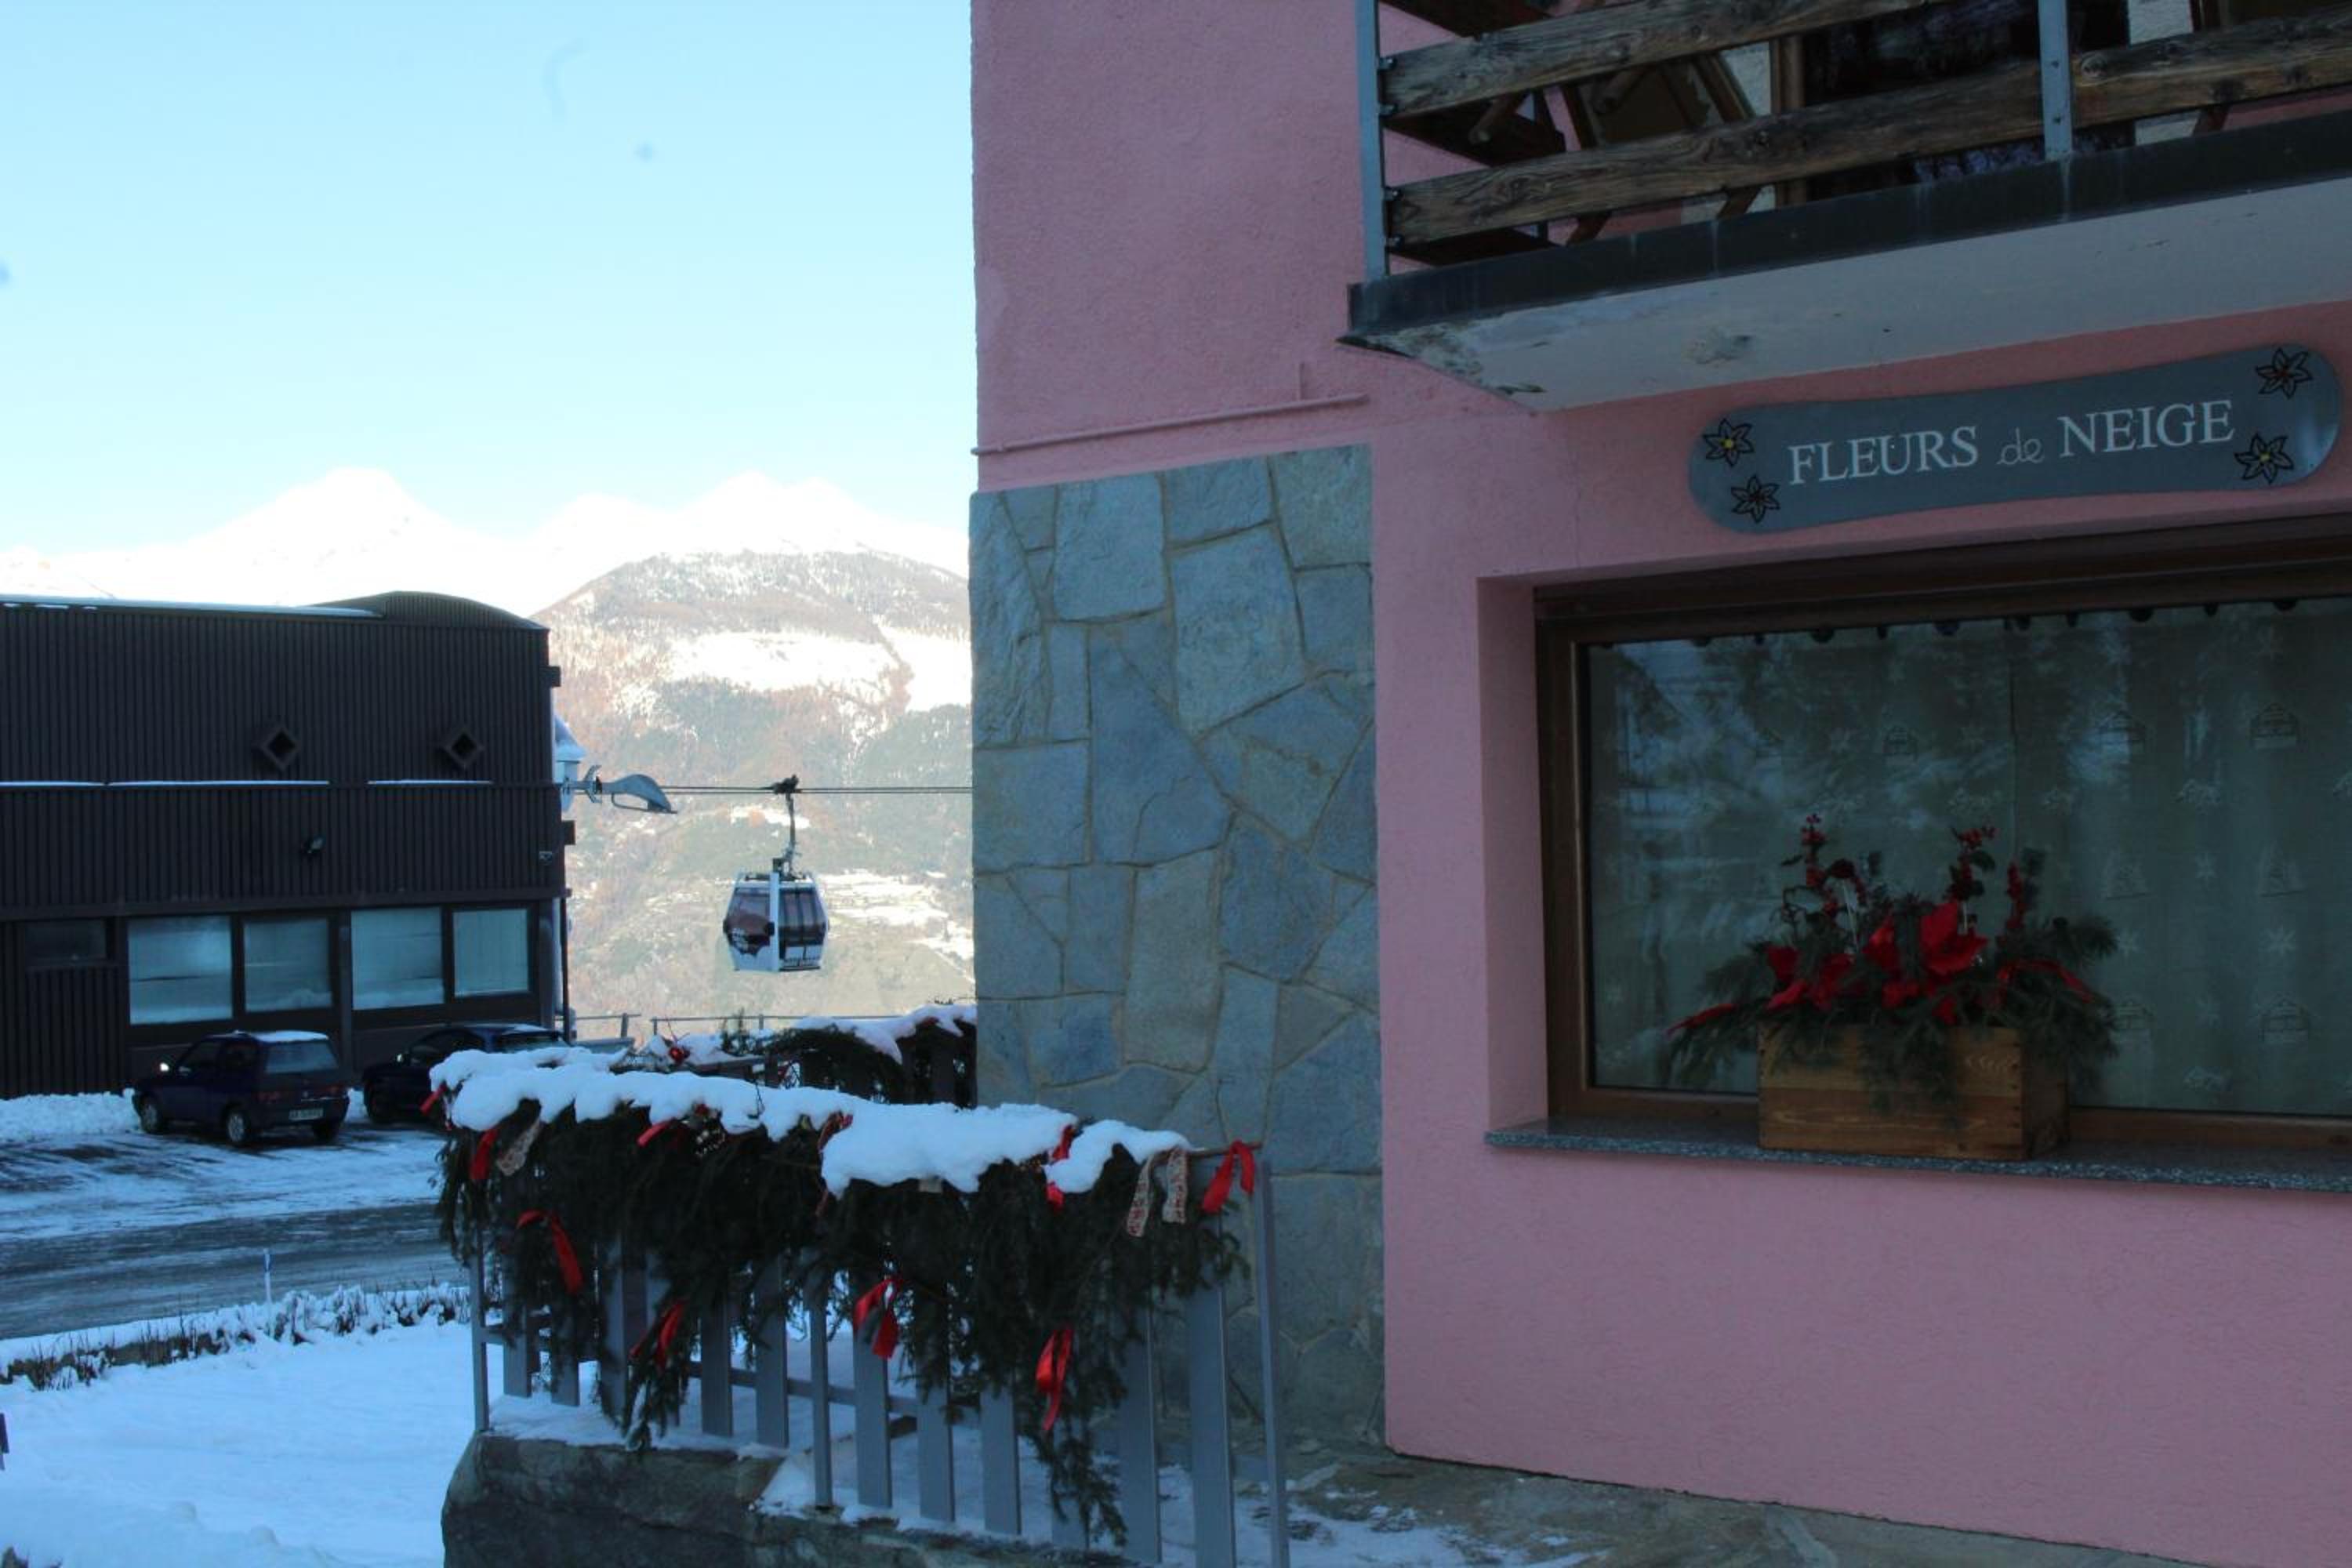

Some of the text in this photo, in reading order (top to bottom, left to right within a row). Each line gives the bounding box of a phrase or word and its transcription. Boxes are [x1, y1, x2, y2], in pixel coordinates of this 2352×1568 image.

[1788, 400, 2235, 485] FLEURS de NEIGE
